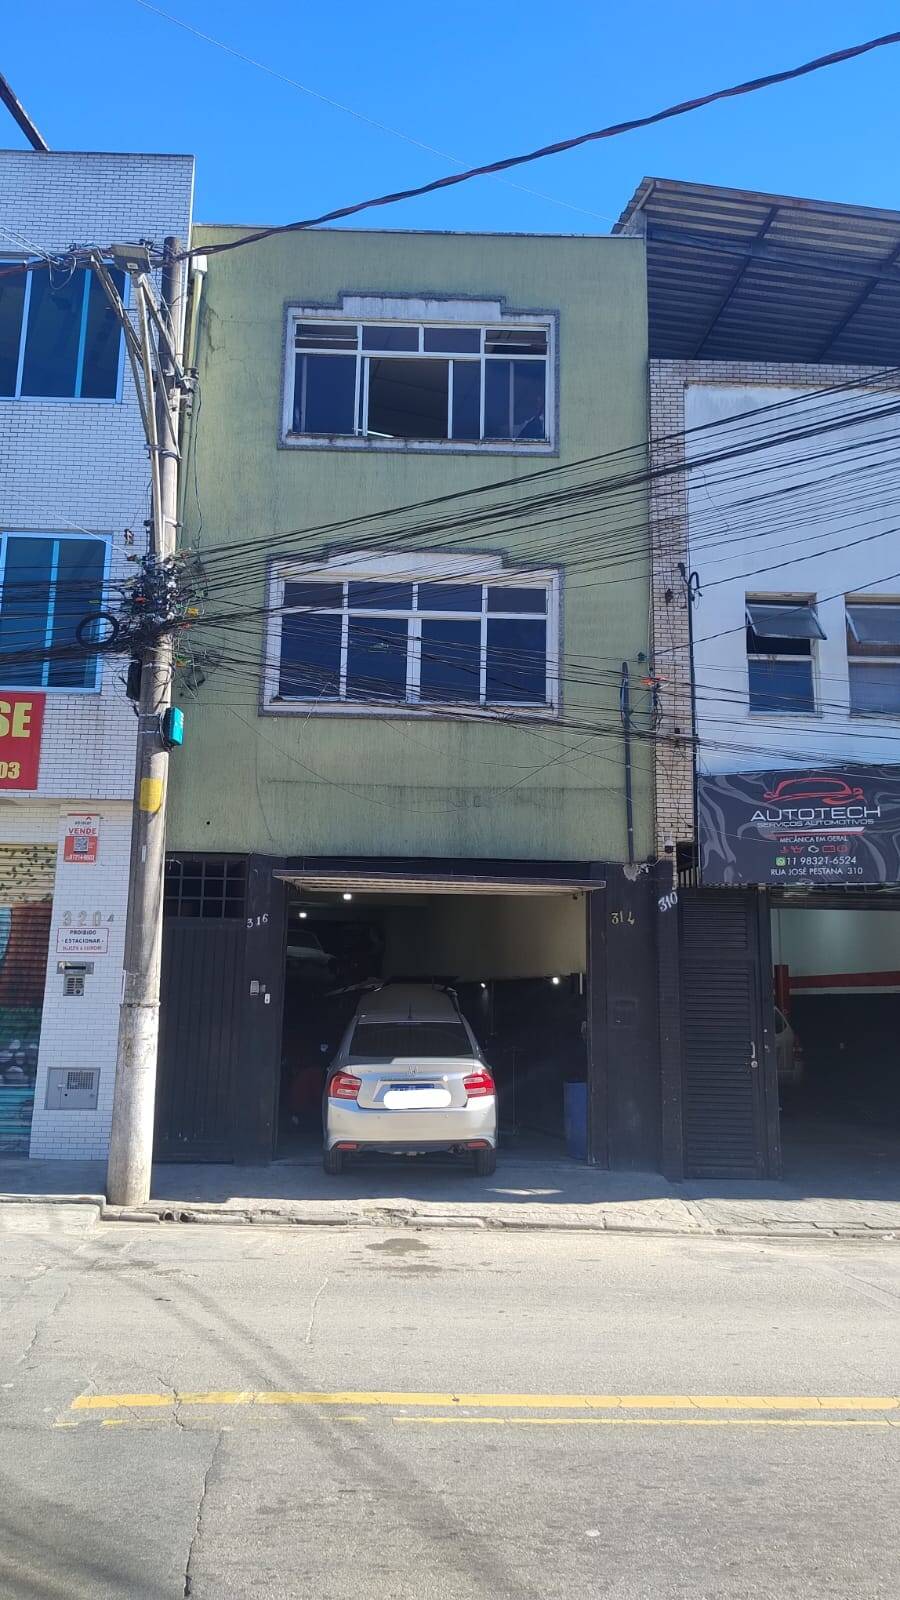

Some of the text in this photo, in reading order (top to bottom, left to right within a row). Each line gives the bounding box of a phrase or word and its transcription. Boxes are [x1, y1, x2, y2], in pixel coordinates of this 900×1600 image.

[750, 806, 881, 822] AUTOTECH
[68, 827, 97, 835] VENDE
[800, 856, 857, 865] 98321-6524
[770, 867, 863, 876] RUA JOSÉ PESTANA 310
[657, 891, 678, 912] 310
[246, 913, 269, 928] 316
[610, 911, 635, 925] 314
